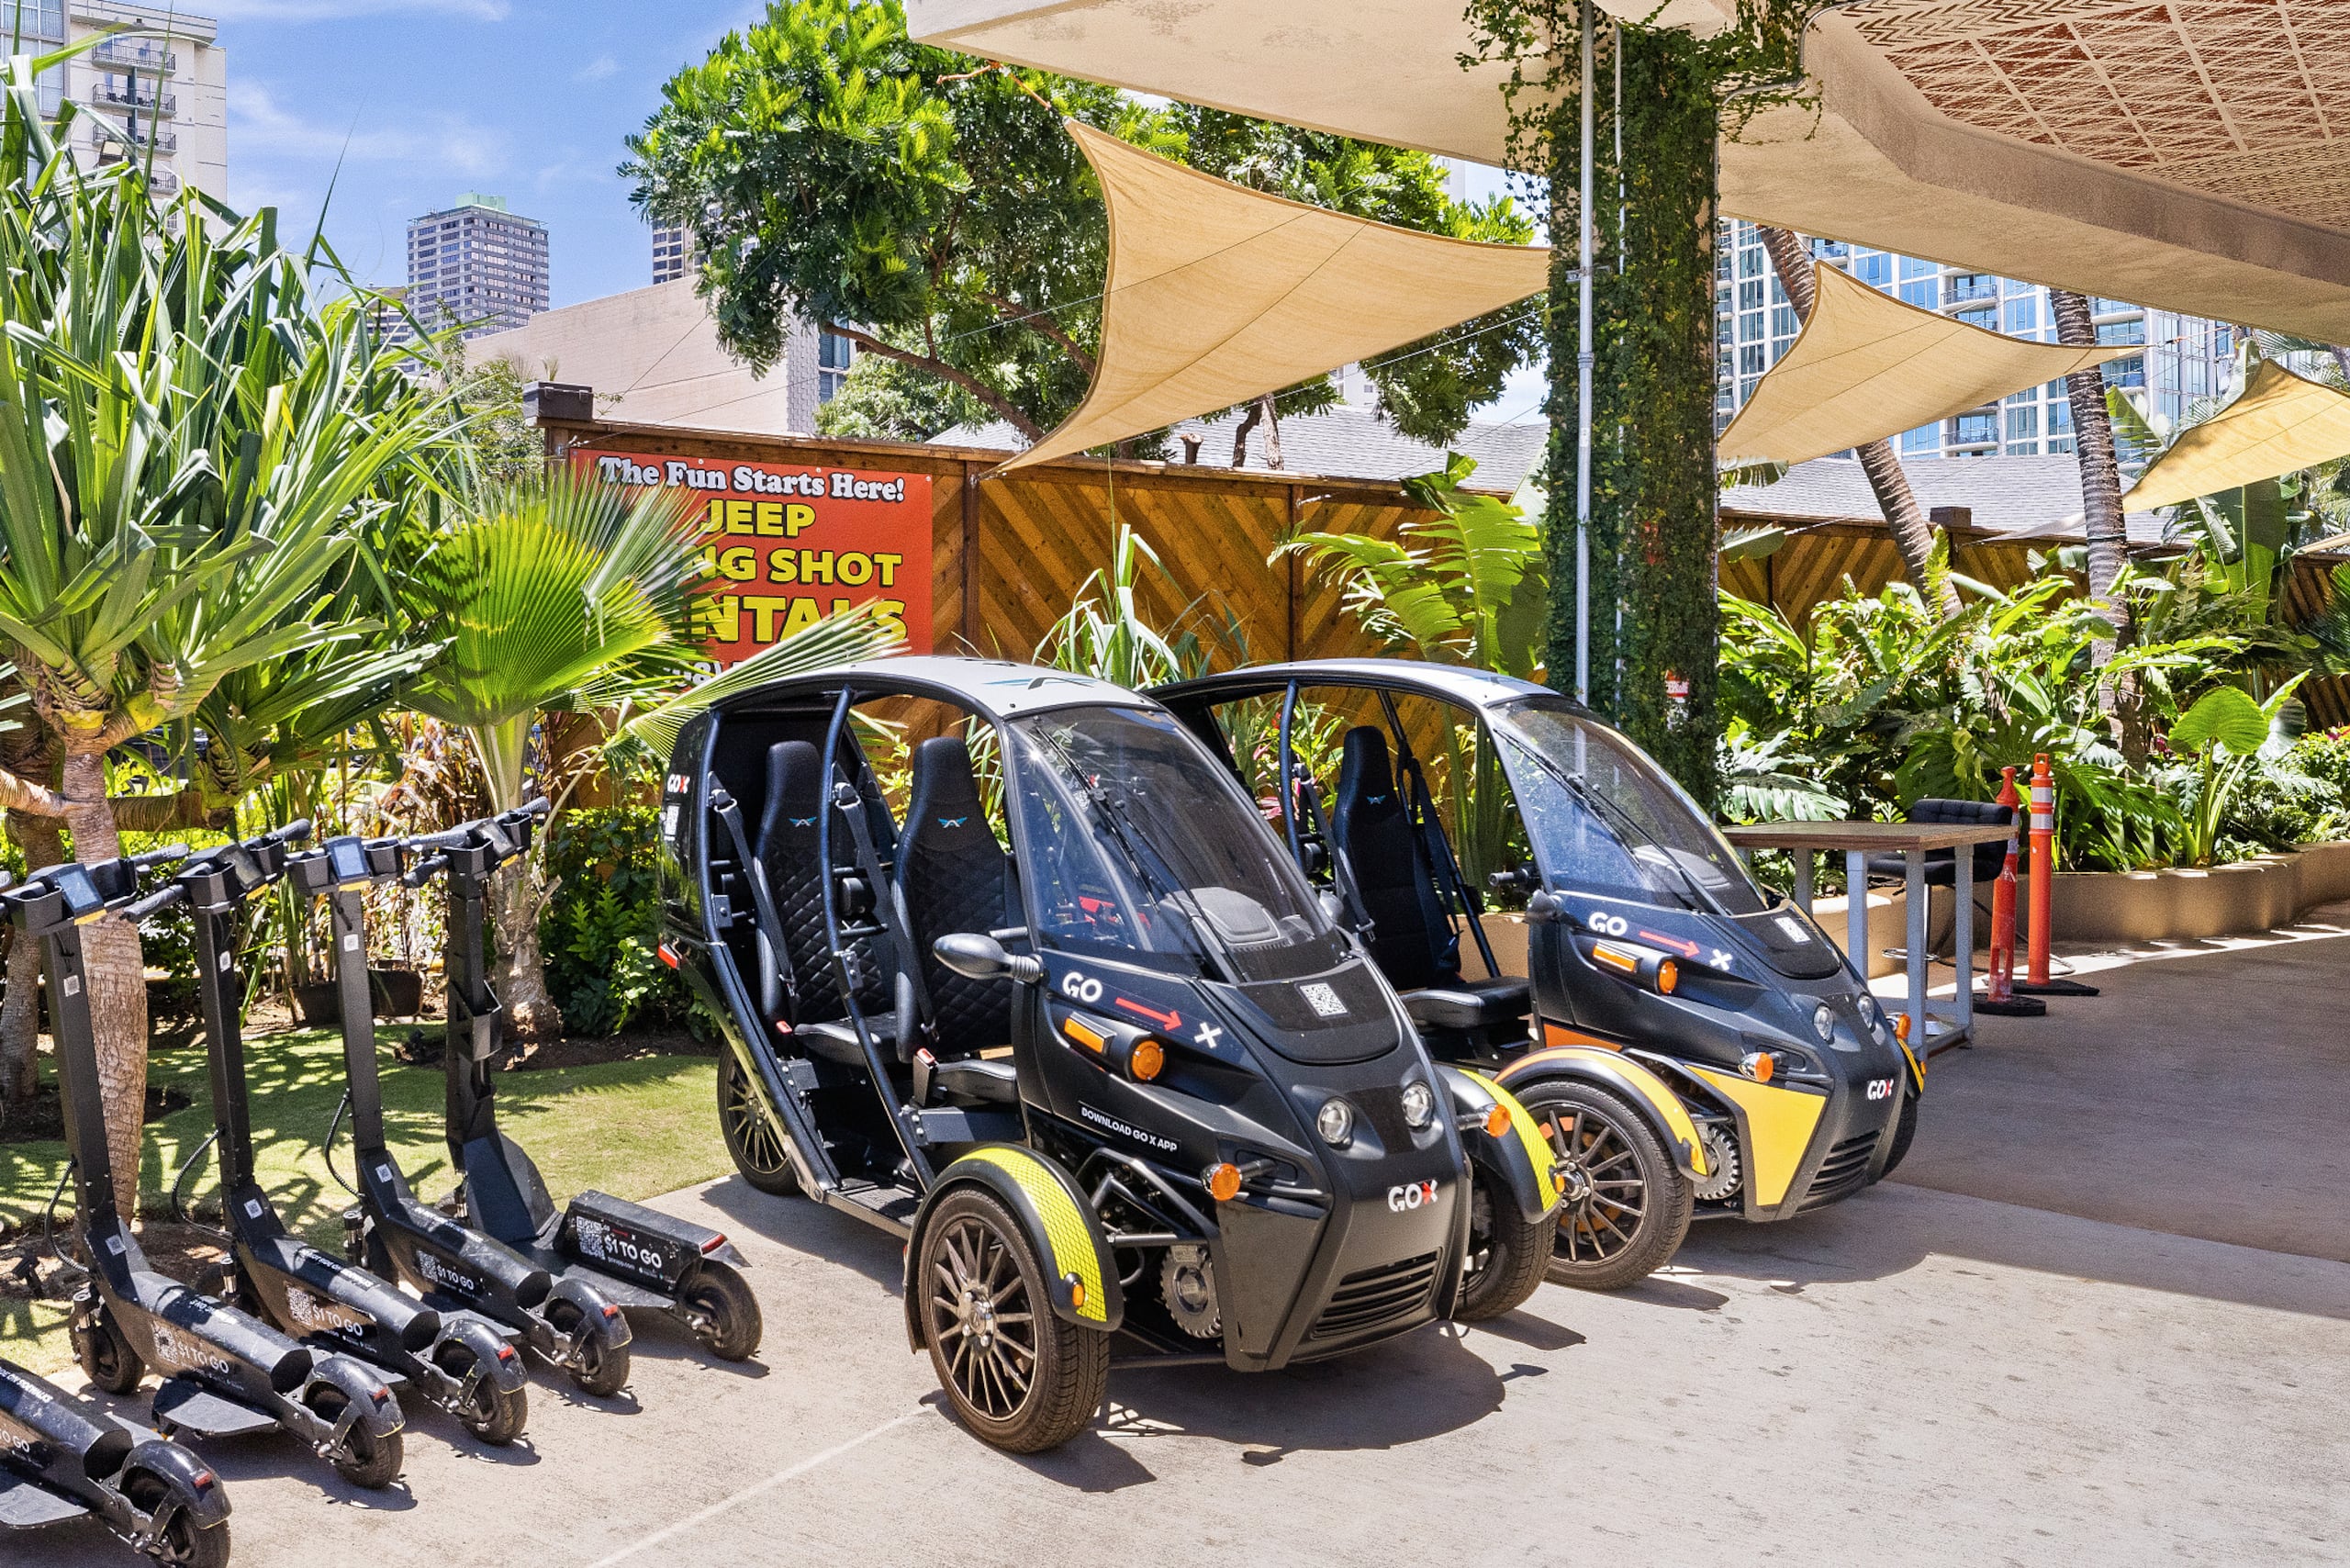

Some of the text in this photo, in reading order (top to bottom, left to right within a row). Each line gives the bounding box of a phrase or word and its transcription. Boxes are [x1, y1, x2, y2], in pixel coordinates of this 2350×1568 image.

[599, 456, 906, 501] The Fun Starts Here!
[700, 498, 817, 538] JEEP
[680, 544, 902, 587] NG SHOT
[1588, 911, 1734, 971] GO X
[1061, 971, 1224, 1049] GO X
[1080, 1106, 1178, 1152] DOWNLOAD GO X APP
[604, 1234, 619, 1254] $1
[619, 1240, 638, 1260] TO
[640, 1249, 662, 1269] GO
[446, 1270, 459, 1283] TO
[459, 1276, 475, 1291] GO
[312, 1304, 364, 1338] $1 TO GO
[177, 1341, 229, 1374] $1 TO GO
[13, 1435, 30, 1453] GO
